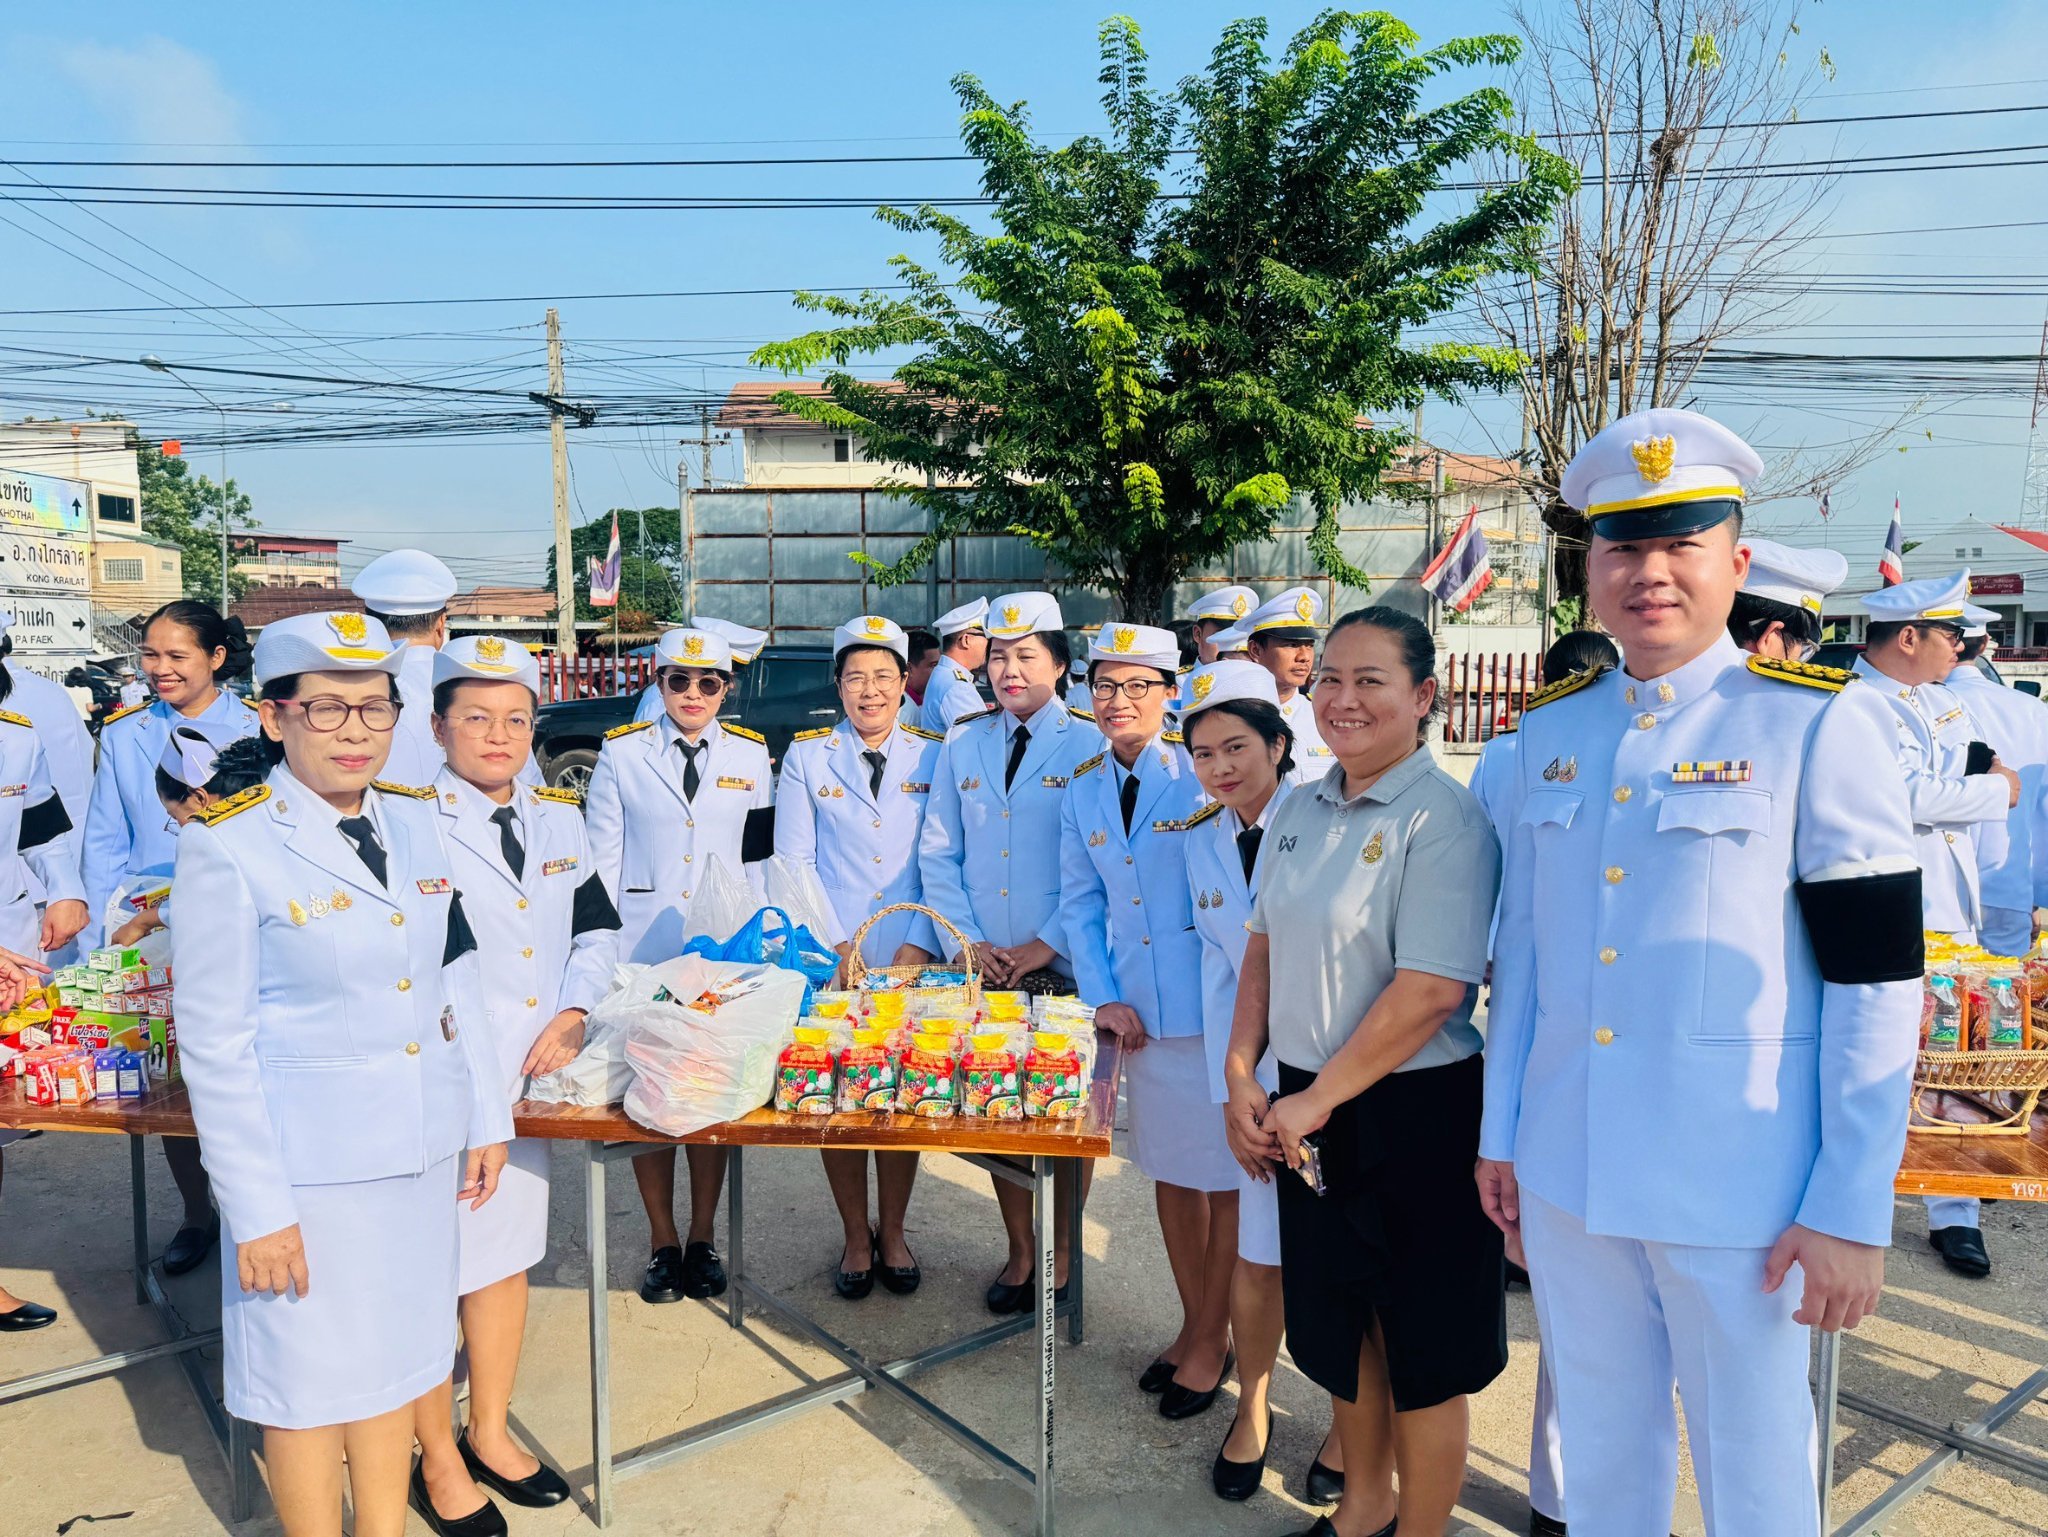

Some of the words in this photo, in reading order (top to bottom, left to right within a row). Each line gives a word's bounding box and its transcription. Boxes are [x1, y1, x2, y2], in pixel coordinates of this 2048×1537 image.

[26, 573, 50, 584] KONG
[53, 575, 85, 586] KRAILAT
[15, 635, 28, 644] PA
[30, 635, 54, 644] FAEK
[52, 1015, 71, 1024] FREE
[53, 1025, 64, 1041] 2
